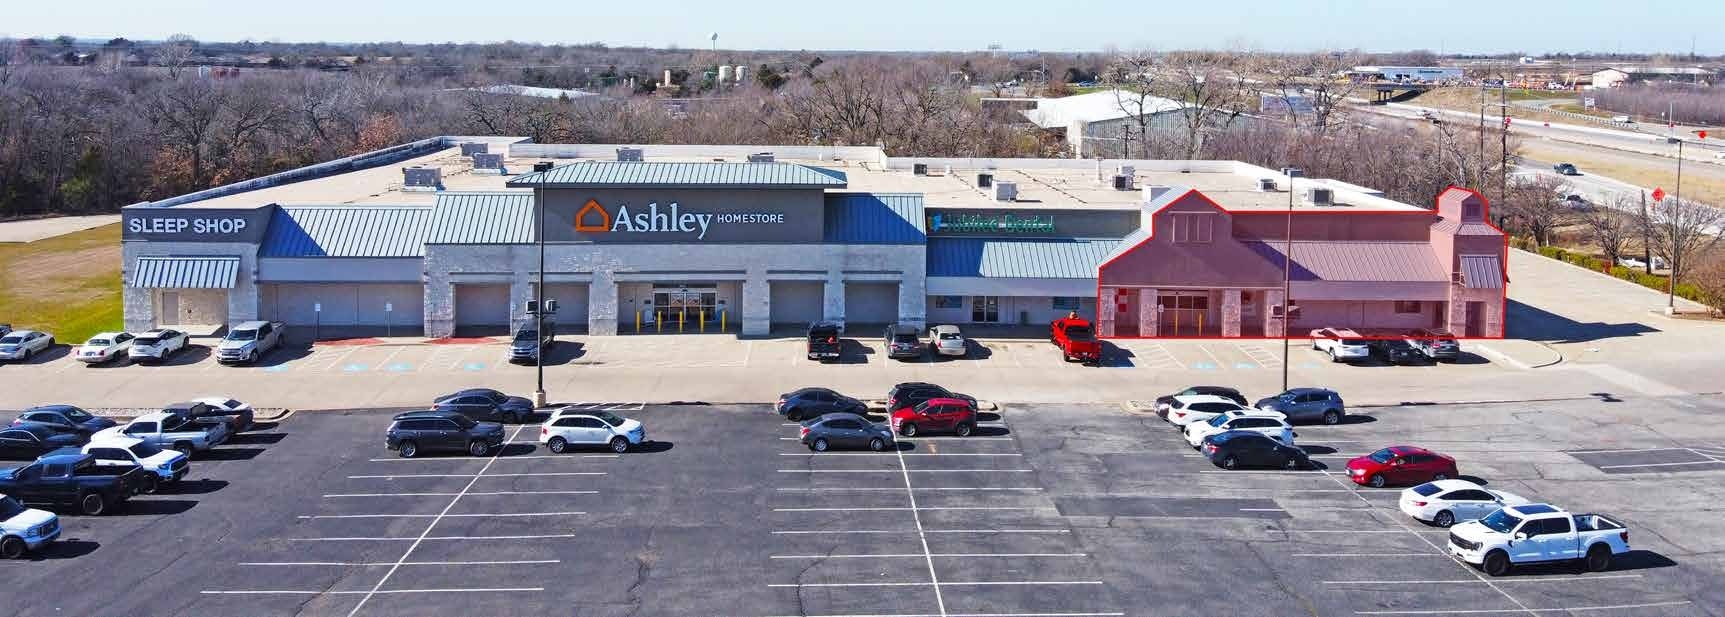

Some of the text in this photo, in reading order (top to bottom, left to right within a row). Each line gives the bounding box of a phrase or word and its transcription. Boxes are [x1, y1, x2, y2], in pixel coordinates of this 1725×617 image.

[129, 218, 246, 233] SLEEP SHOP
[611, 202, 784, 240] Ashley HOMESTORE
